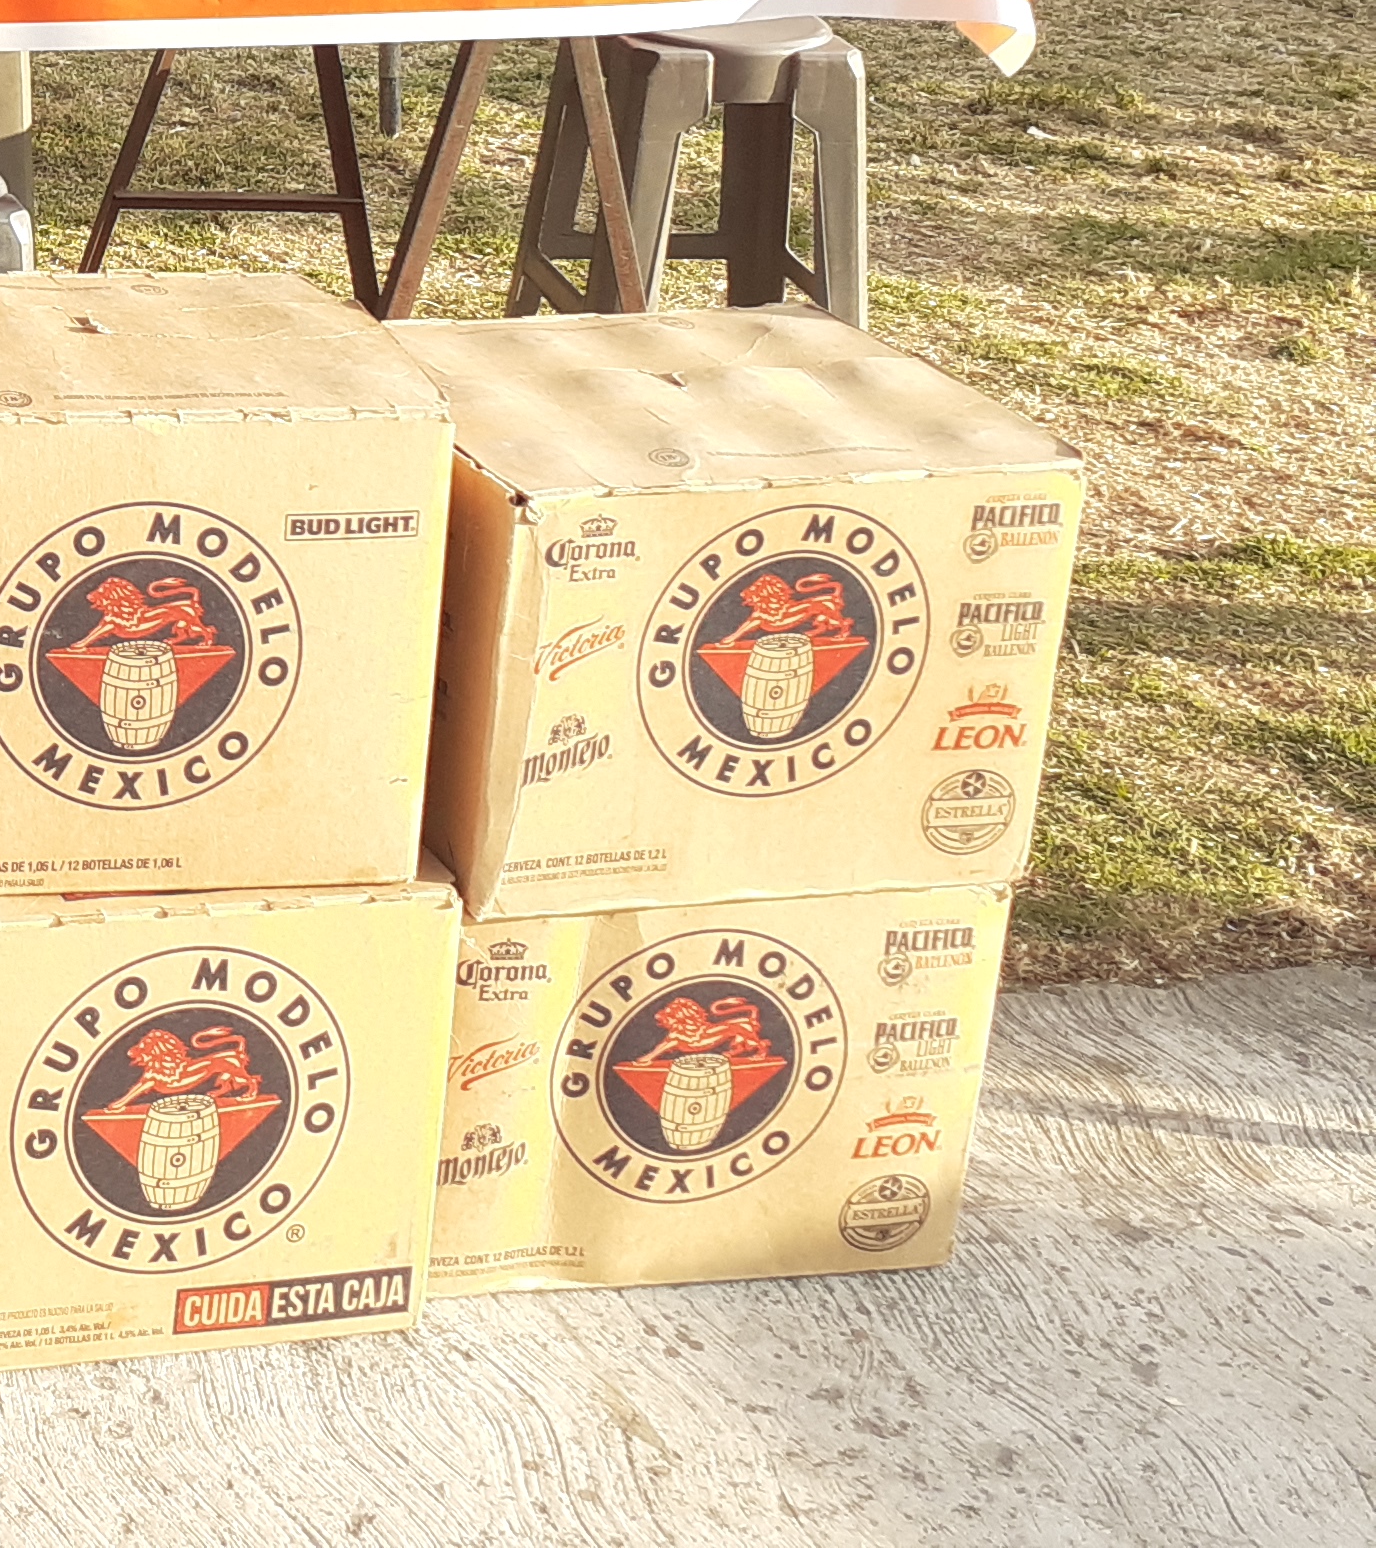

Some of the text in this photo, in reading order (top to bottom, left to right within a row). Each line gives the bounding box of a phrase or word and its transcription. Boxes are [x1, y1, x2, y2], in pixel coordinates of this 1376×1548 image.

[289, 518, 341, 537] BUD
[970, 503, 1062, 532] PACIFICO
[544, 538, 637, 570] Corona
[568, 564, 617, 582] Extra
[146, 511, 290, 689] MODELO
[648, 514, 921, 689] GRUPO MODELO
[956, 600, 1045, 628] PACIFICO
[1001, 622, 1040, 641] LIGHT
[533, 614, 626, 682] Victoria
[931, 723, 1028, 751] LEON
[31, 730, 251, 801] MEXICO
[520, 732, 611, 788] Montejo
[675, 718, 873, 788] MEXICO
[934, 803, 1008, 819] ESTRELLA
[11, 861, 26, 872] DE
[51, 860, 57, 871] L
[68, 859, 80, 871] 12
[82, 858, 134, 870] BOTELLAS
[136, 857, 150, 869] DE
[176, 857, 182, 868] L
[502, 859, 542, 873] CERVEZA
[585, 851, 632, 864] BOTELLAS
[884, 927, 974, 955] PACIFICO
[455, 959, 548, 989] Corona
[478, 984, 529, 1002] Extra
[560, 938, 839, 1098] GRUPO MODELO
[875, 1018, 958, 1046] PACIFICO
[24, 977, 149, 1160] GRUPO
[190, 957, 336, 1135] MODELO
[448, 1032, 540, 1091] Victoria
[851, 1130, 942, 1159] LEON
[593, 1130, 792, 1195] MEXICO
[63, 1182, 293, 1264] MEXICO
[852, 1204, 919, 1221] ESTRELLA
[183, 1275, 407, 1329] CUIDA ESTA CAJA
